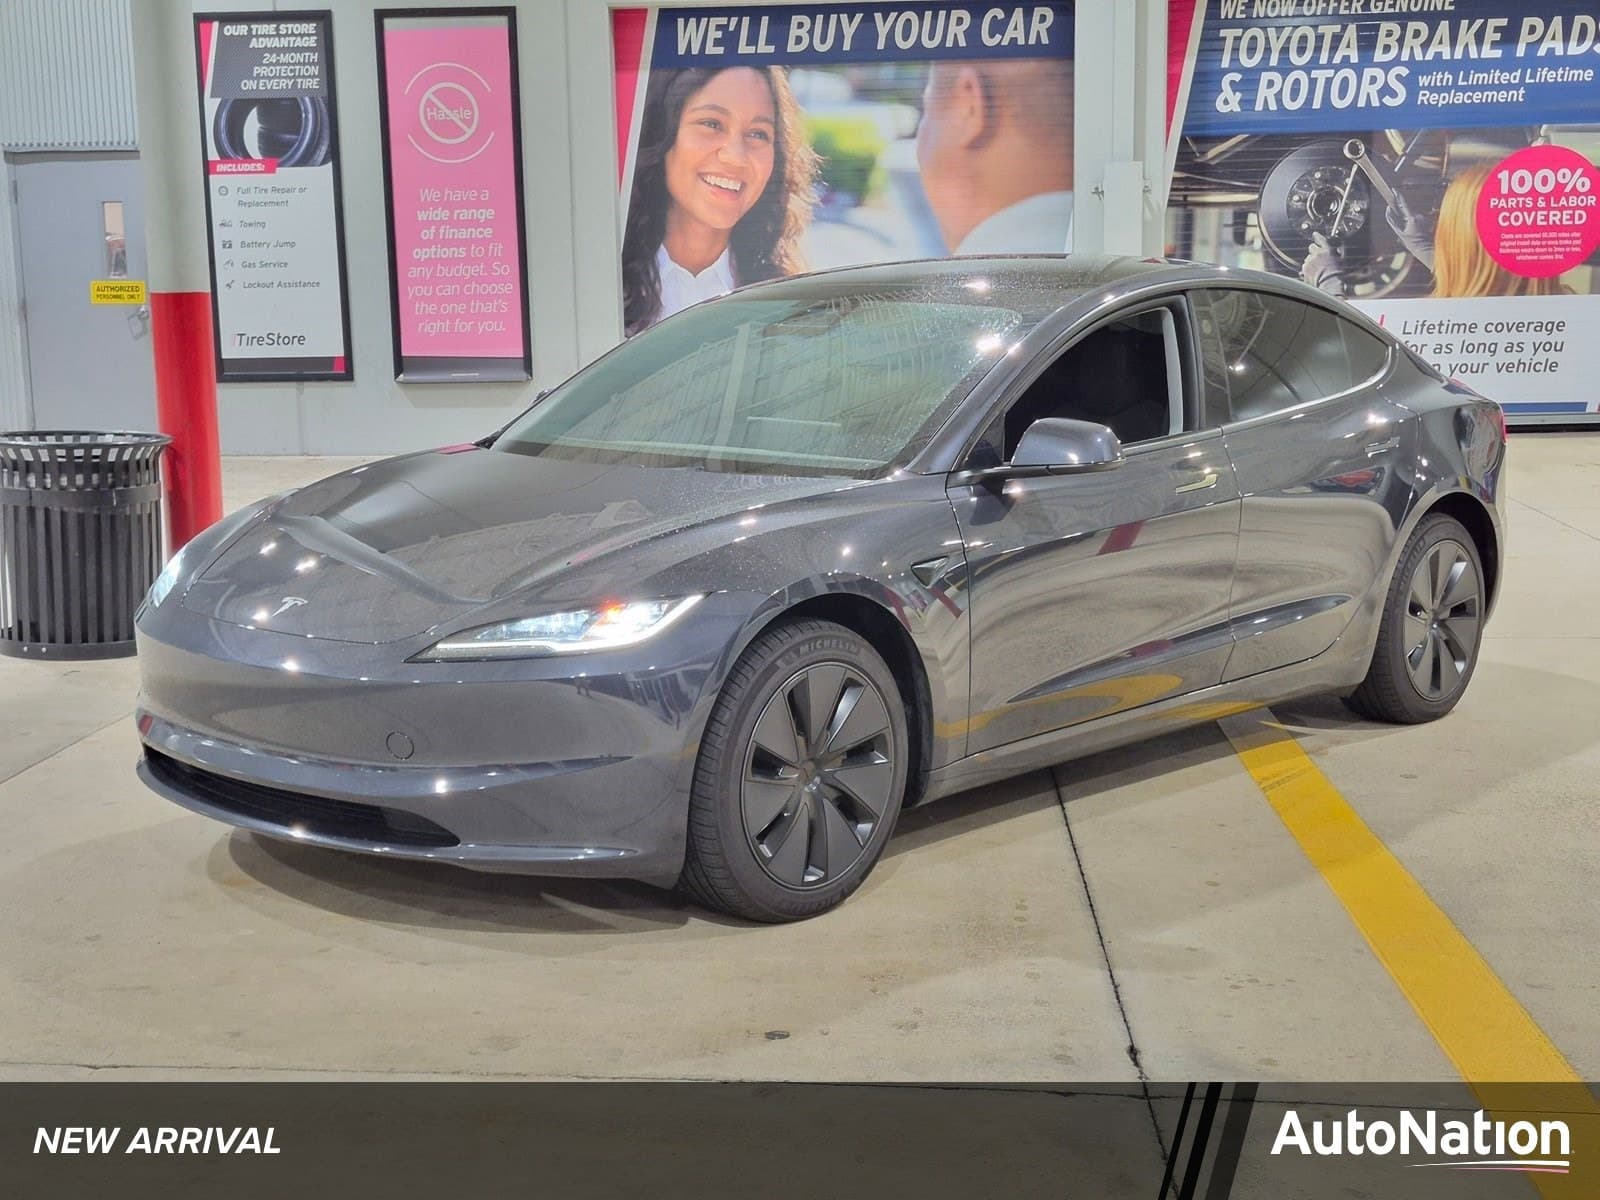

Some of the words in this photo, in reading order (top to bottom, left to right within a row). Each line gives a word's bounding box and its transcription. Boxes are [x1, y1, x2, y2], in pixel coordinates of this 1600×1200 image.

[1220, 0, 1247, 19] WE
[1252, 0, 1297, 18] NOW
[1303, 0, 1363, 16] OFFER
[224, 24, 248, 35] OUR
[251, 24, 277, 35] TIRE
[279, 24, 316, 34] STORE
[676, 16, 775, 55] WE'LL
[787, 12, 864, 53] BUY
[874, 10, 970, 50] YOUR
[981, 7, 1054, 46] CAR
[250, 36, 317, 48] ADVANTAGE
[1219, 24, 1358, 68] TOYOTA
[1373, 18, 1508, 62] BRAKE
[1516, 15, 1600, 58] PAD
[262, 52, 318, 64] 24-MONTH
[253, 66, 318, 77] PROTECTION
[1418, 72, 1452, 86] with
[1458, 68, 1521, 86] Limited
[1526, 66, 1594, 83] Lifetime
[241, 80, 257, 90] ON
[259, 79, 293, 90] EVERY
[296, 78, 320, 89] TIRE
[1216, 72, 1242, 113] &
[1254, 66, 1410, 111] ROTORS
[1417, 87, 1526, 108] Replacement
[216, 163, 265, 172] INCLUDES:
[1498, 168, 1591, 194] 100%
[271, 186, 296, 195] Repair
[420, 188, 441, 201] We
[444, 187, 477, 201] have
[480, 190, 489, 200] a
[238, 199, 289, 208] Replacement
[1490, 197, 1533, 208] PARTS
[1537, 197, 1546, 207] &
[1550, 196, 1597, 207] LABOR
[417, 207, 450, 221] wide
[454, 208, 495, 222] range
[1498, 210, 1587, 226] COVERED
[239, 220, 266, 229] Towing
[421, 226, 436, 240] of
[439, 225, 493, 239] finance
[240, 240, 271, 249] Battery
[273, 240, 296, 249] Jump
[413, 244, 466, 260] options
[470, 244, 484, 257] to
[488, 243, 503, 257] fit
[241, 260, 256, 268] Gas
[258, 260, 288, 268] Service
[408, 265, 432, 280] any
[437, 263, 488, 279] budget.
[492, 262, 510, 276] So
[243, 281, 274, 289] Lockout
[277, 280, 320, 289] Assistance
[407, 284, 432, 299] you
[436, 284, 460, 296] can
[464, 280, 513, 295] choose
[415, 301, 437, 314] the
[441, 303, 466, 314] one
[470, 299, 508, 313] that's
[418, 319, 450, 335] right
[454, 318, 473, 332] for
[477, 321, 506, 334] you.
[1402, 320, 1478, 335] Lifetime
[1484, 320, 1566, 338] coverage
[1433, 343, 1453, 354] as
[1460, 339, 1498, 356] long
[1504, 342, 1525, 353] as
[1532, 340, 1564, 356] you
[1449, 362, 1489, 377] your
[1496, 358, 1559, 374] vehicle
